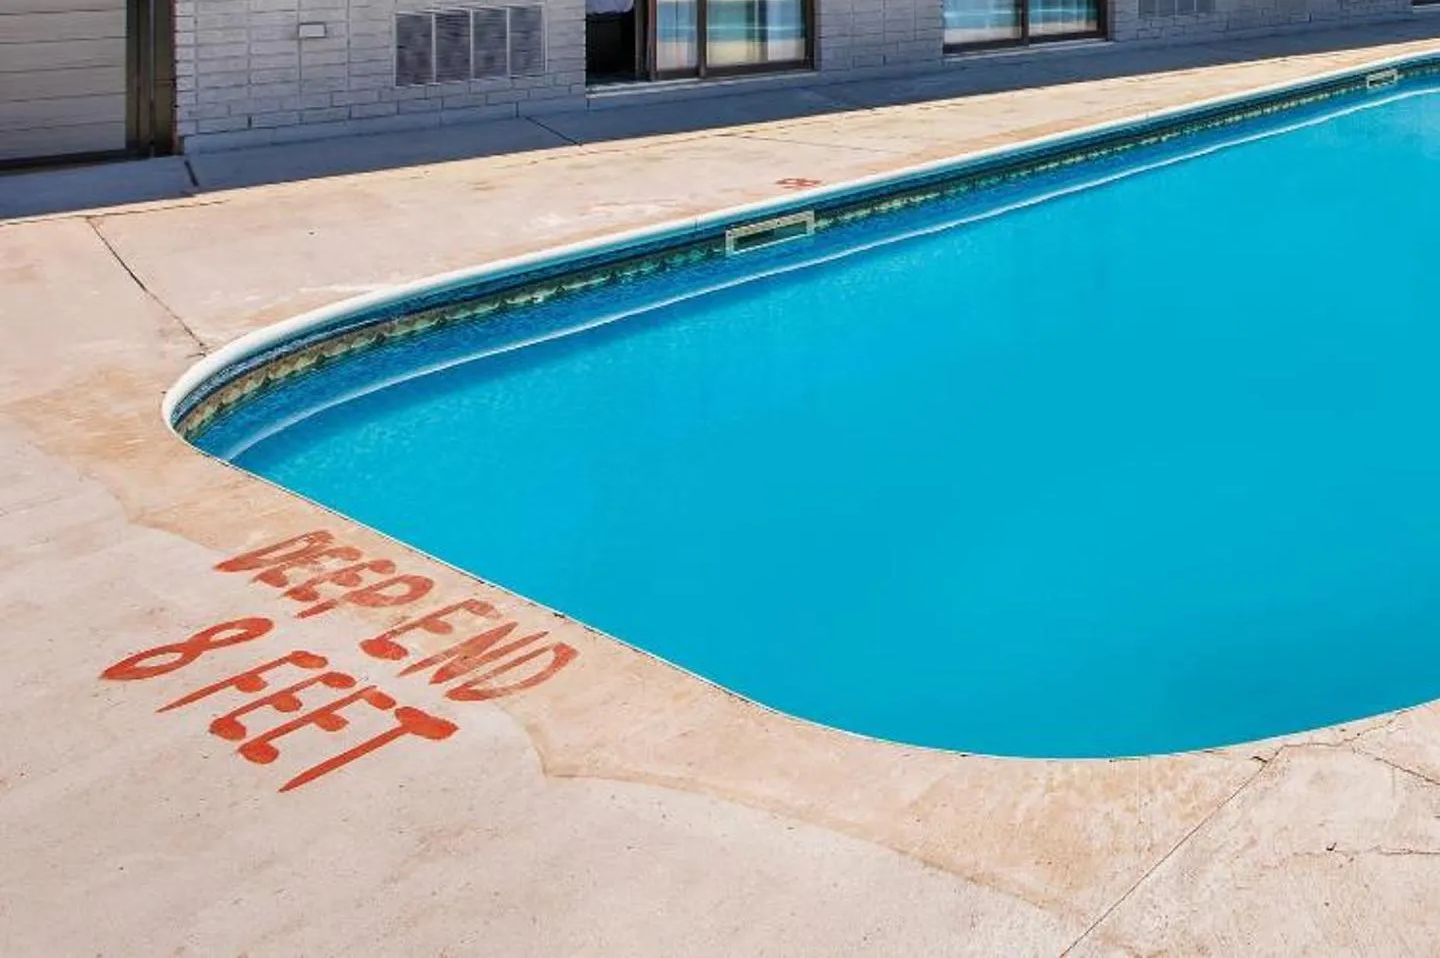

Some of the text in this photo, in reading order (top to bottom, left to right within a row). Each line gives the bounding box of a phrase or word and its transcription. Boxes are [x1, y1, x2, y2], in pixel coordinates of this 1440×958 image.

[214, 530, 577, 702] DEEP END
[100, 617, 459, 793] 8 FEET
